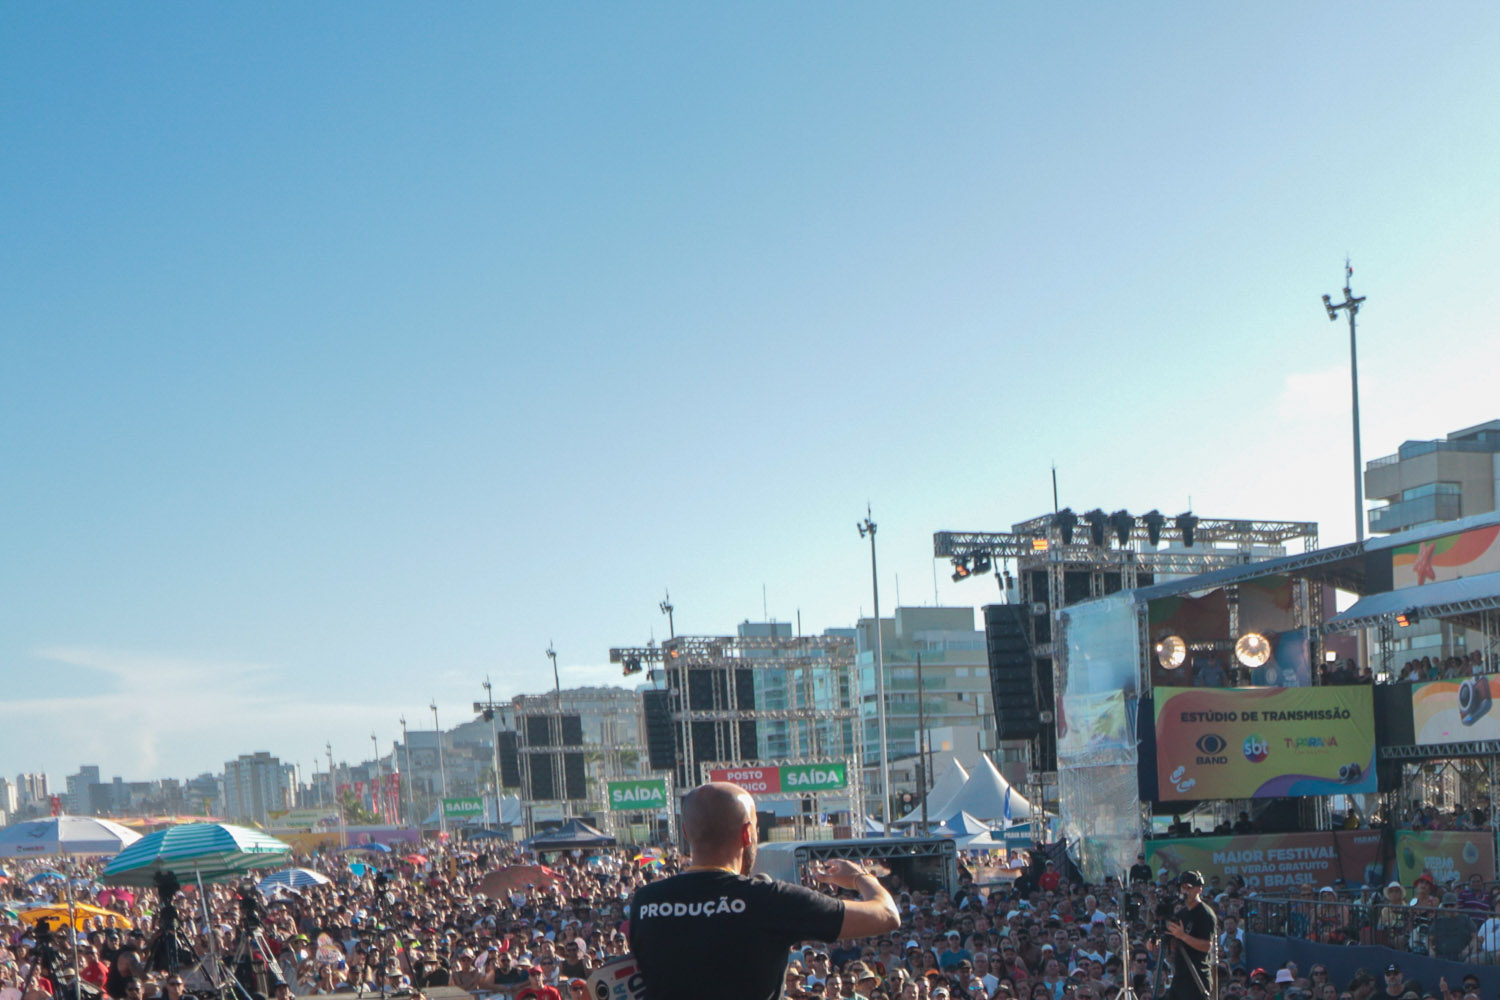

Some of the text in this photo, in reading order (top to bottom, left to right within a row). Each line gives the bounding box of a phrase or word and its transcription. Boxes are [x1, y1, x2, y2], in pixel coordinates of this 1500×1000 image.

[1181, 707, 1350, 722] ESTÚDIO DE TRANSMISSÃO
[1243, 739, 1269, 755] sbt
[1196, 756, 1228, 765] BAND
[727, 771, 763, 781] POSTO
[787, 768, 840, 786] SAÍDA
[613, 785, 662, 802] SAÍDA
[741, 782, 767, 792] DICO
[445, 801, 481, 812] SAÍDA
[1213, 847, 1337, 864] MAIOR FESTIVAL
[1224, 860, 1328, 874] DE VERÃO GRATUITO
[1265, 872, 1317, 887] BRASIL
[640, 896, 746, 919] PRODUÇÃO
